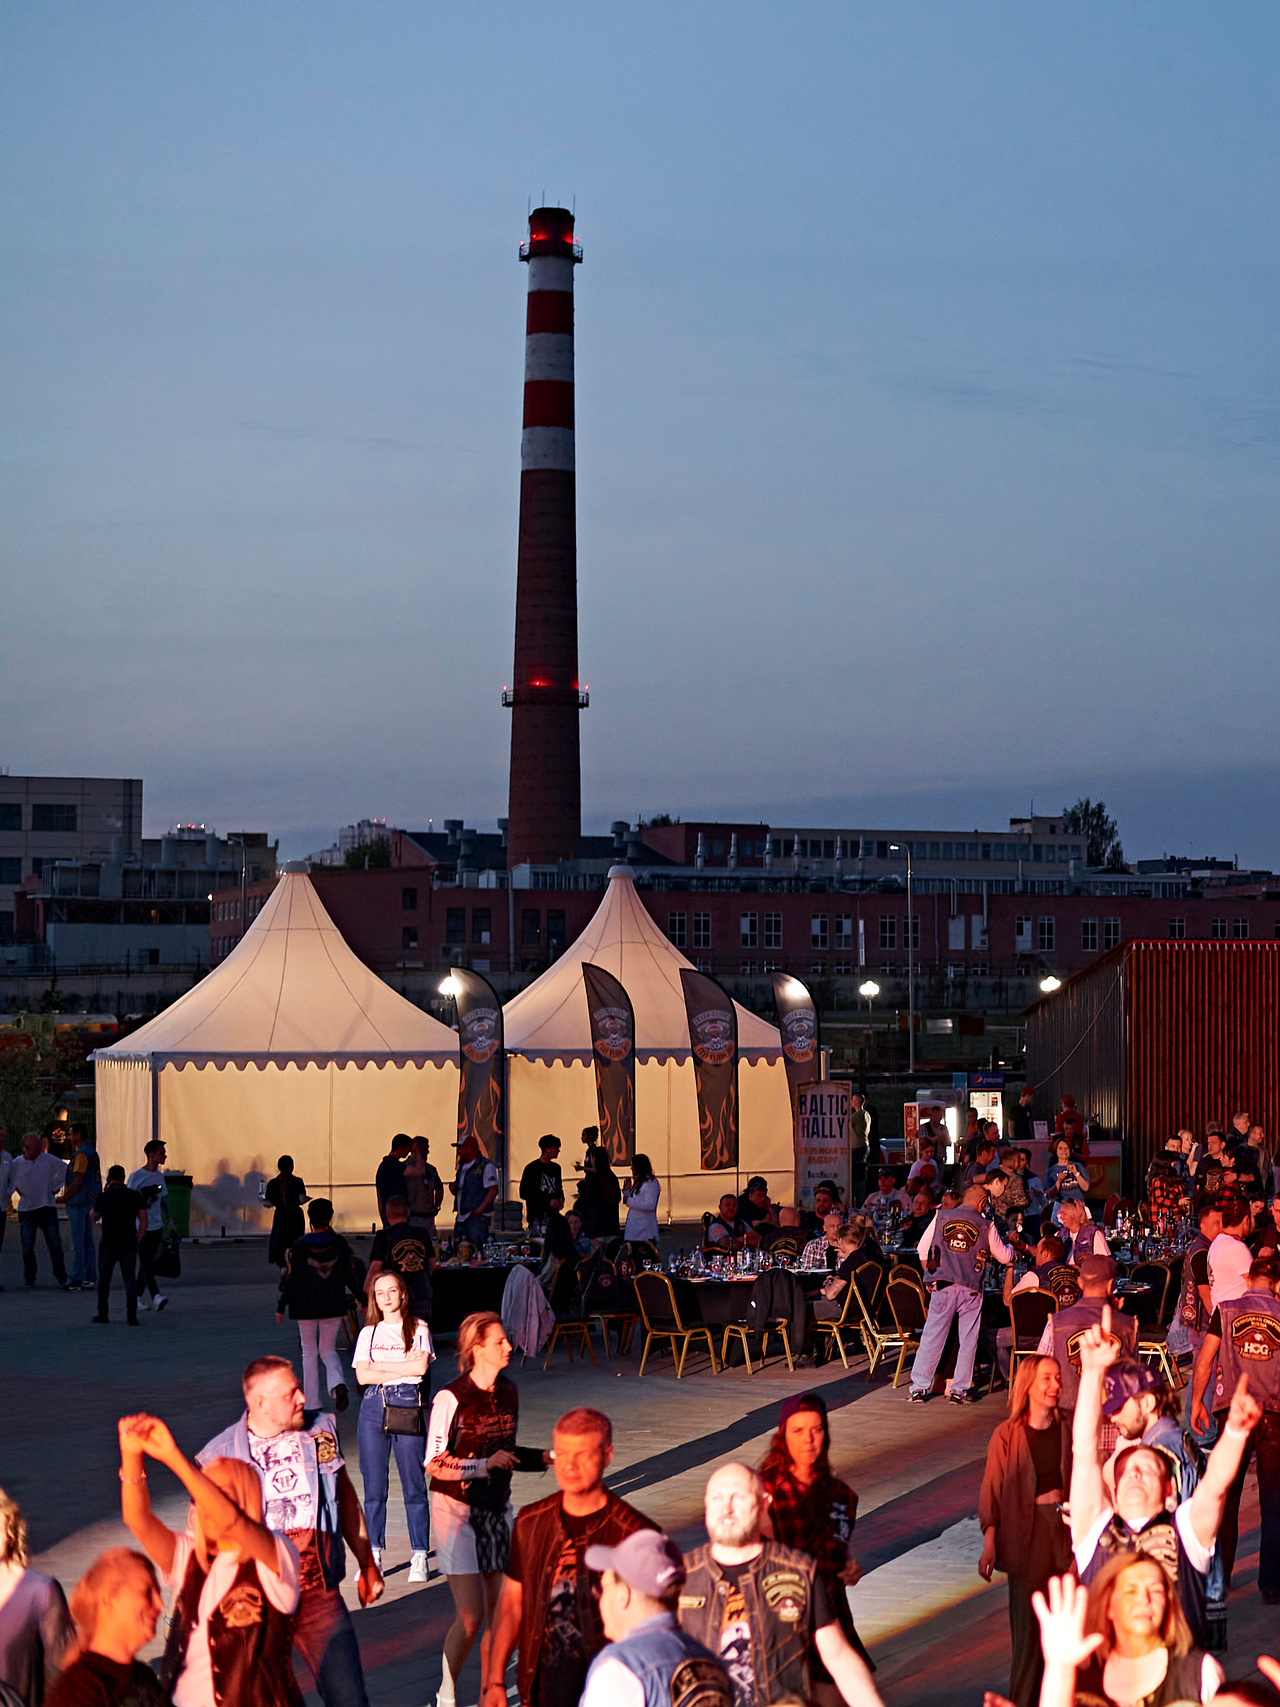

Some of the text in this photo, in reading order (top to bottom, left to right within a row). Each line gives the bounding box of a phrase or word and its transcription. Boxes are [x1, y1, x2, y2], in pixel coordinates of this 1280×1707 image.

[799, 1094, 848, 1116] BALTIC
[801, 1116, 845, 1139] RALLY
[950, 1239, 967, 1249] HOG
[1244, 1341, 1269, 1355] HOG
